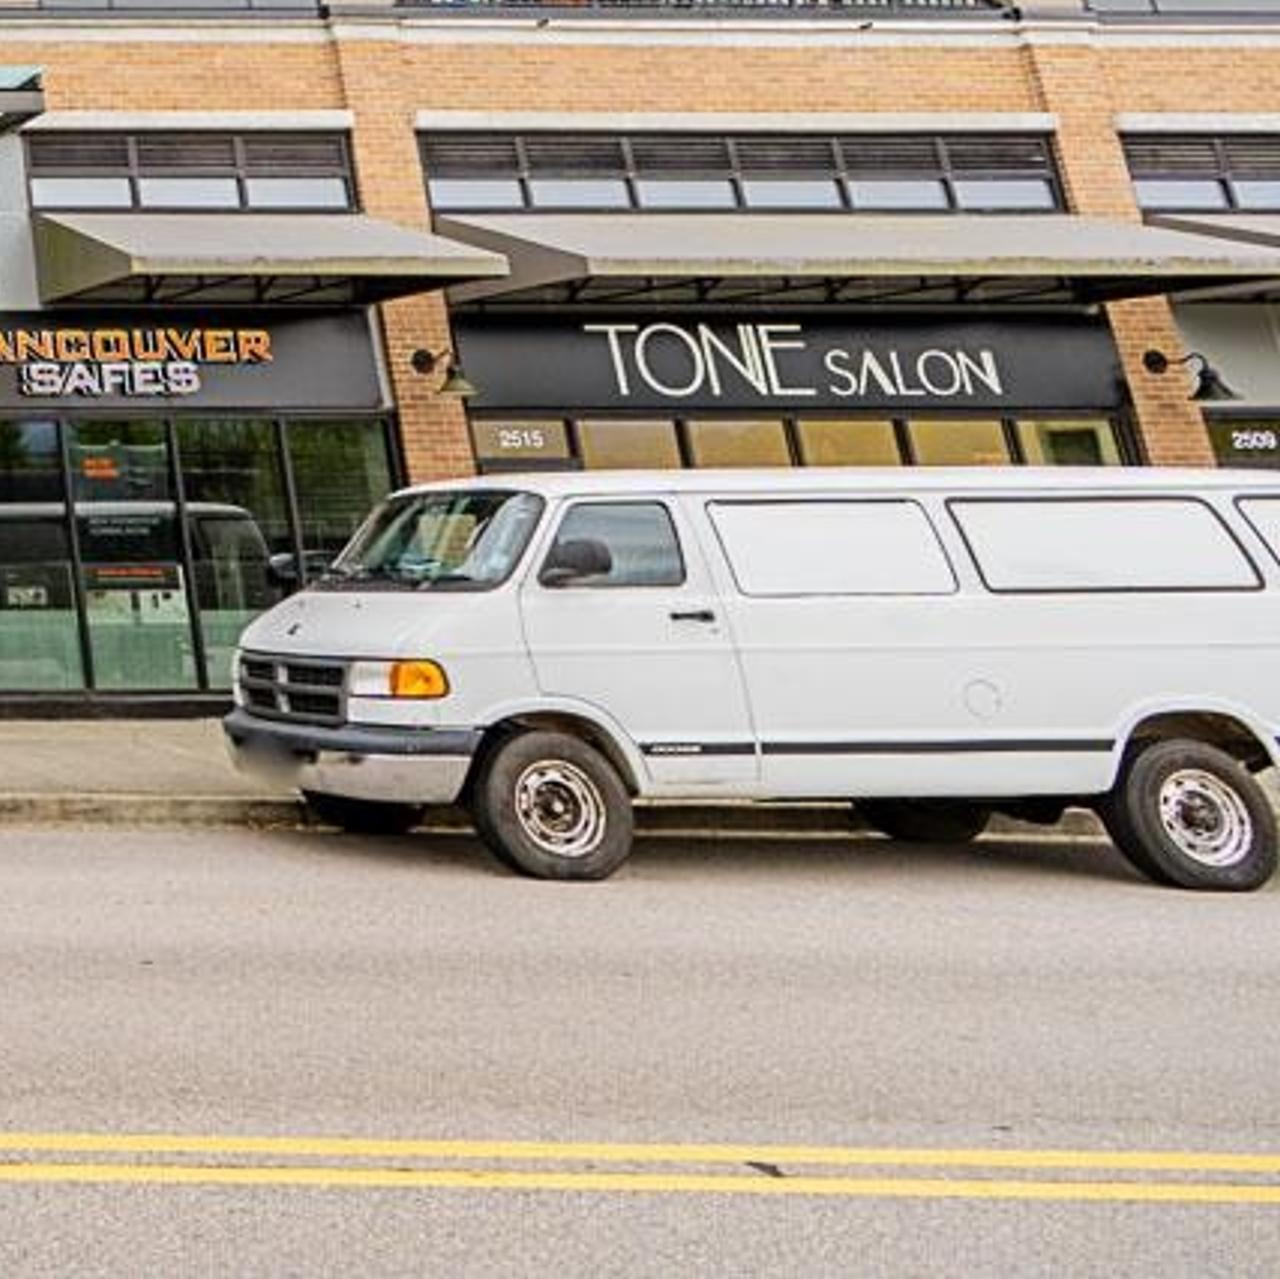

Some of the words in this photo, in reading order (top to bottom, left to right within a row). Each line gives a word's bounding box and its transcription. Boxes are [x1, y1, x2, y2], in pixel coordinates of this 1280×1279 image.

[584, 323, 817, 397] TONE
[824, 348, 1003, 396] SALON
[25, 362, 201, 395] SAFES
[499, 430, 544, 449] 2515
